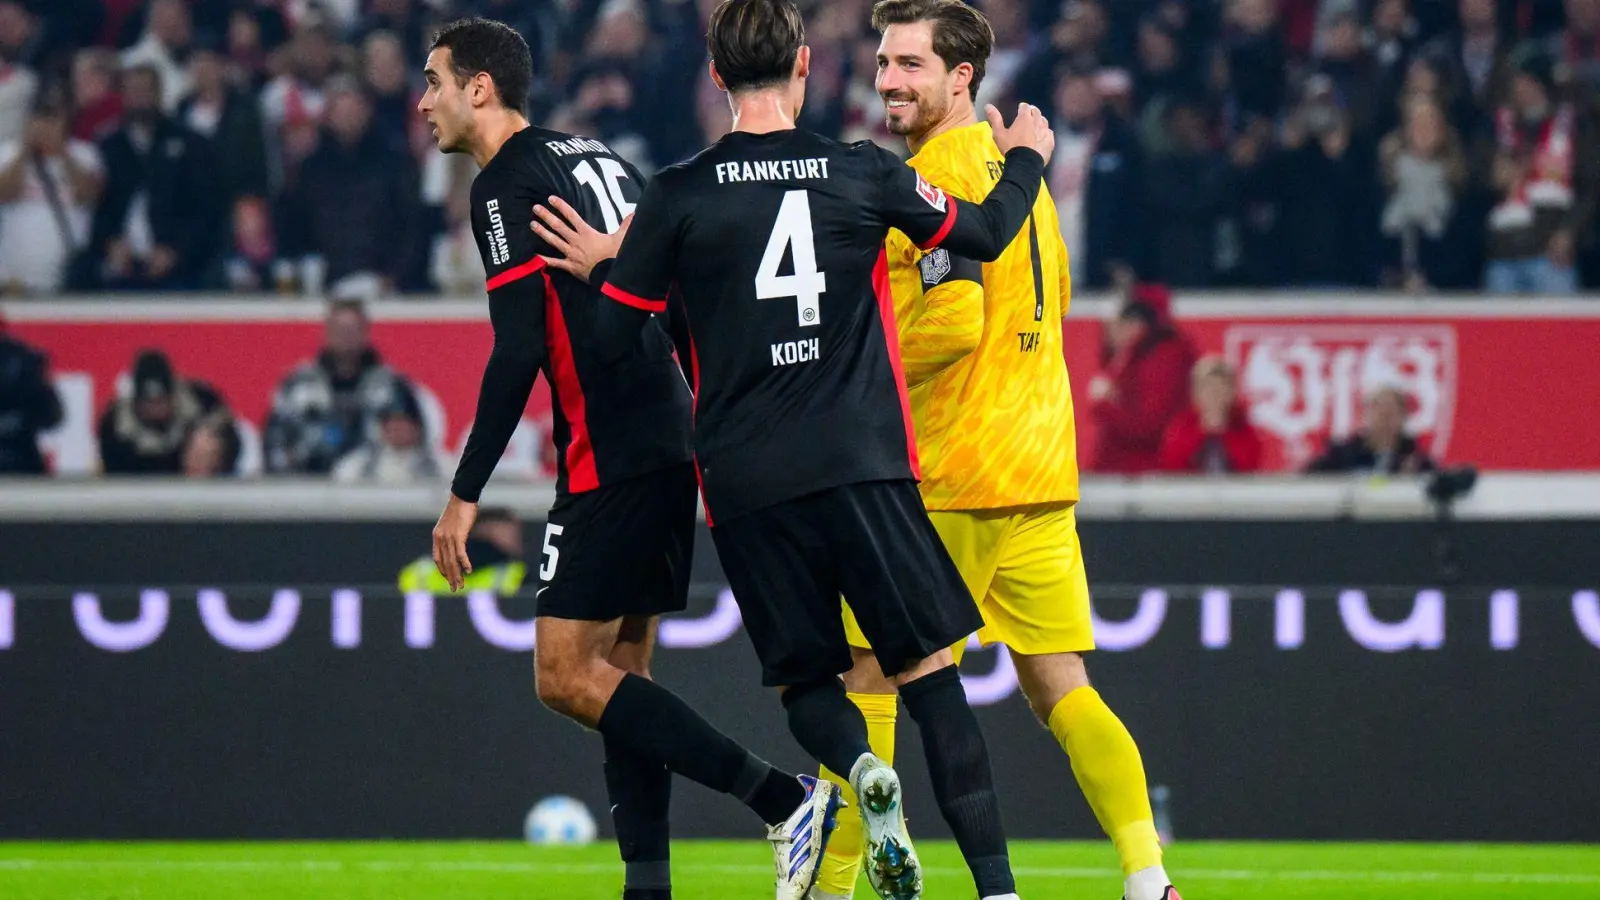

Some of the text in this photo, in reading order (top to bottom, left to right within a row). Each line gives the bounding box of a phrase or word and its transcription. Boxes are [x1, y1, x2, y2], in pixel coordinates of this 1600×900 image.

[715, 158, 829, 184] FRANKFURT
[486, 198, 511, 263] ELOTRANS
[485, 231, 502, 265] reload
[755, 189, 827, 328] 4
[771, 337, 820, 366] KOCH
